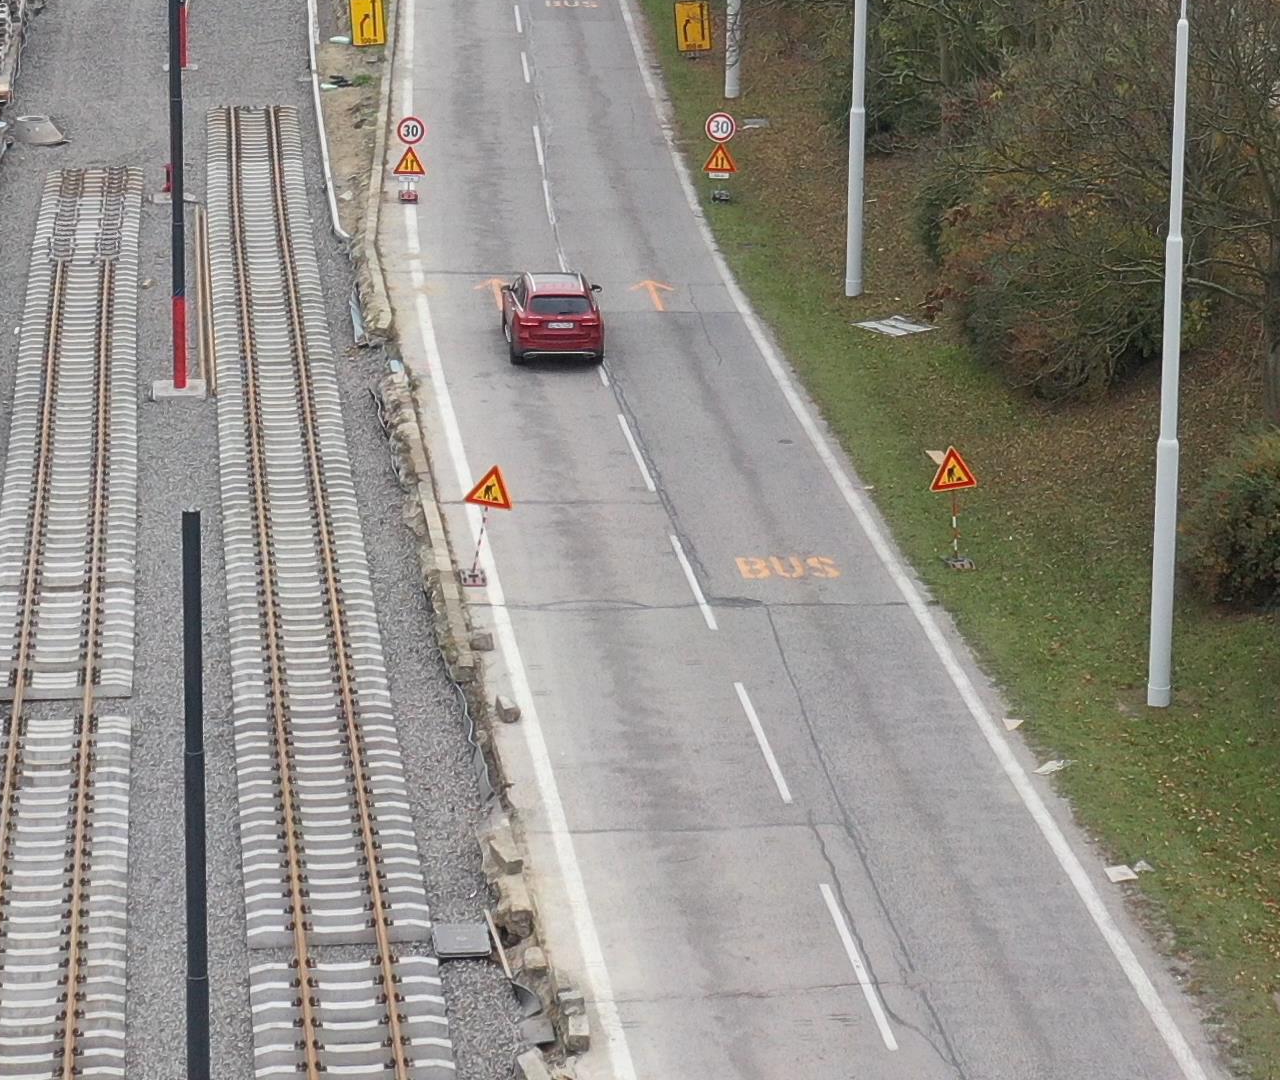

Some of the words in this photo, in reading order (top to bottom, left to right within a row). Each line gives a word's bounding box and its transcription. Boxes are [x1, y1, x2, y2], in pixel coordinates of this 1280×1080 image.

[403, 124, 419, 137] 30
[712, 120, 729, 134] 30
[735, 555, 841, 579] BUS
